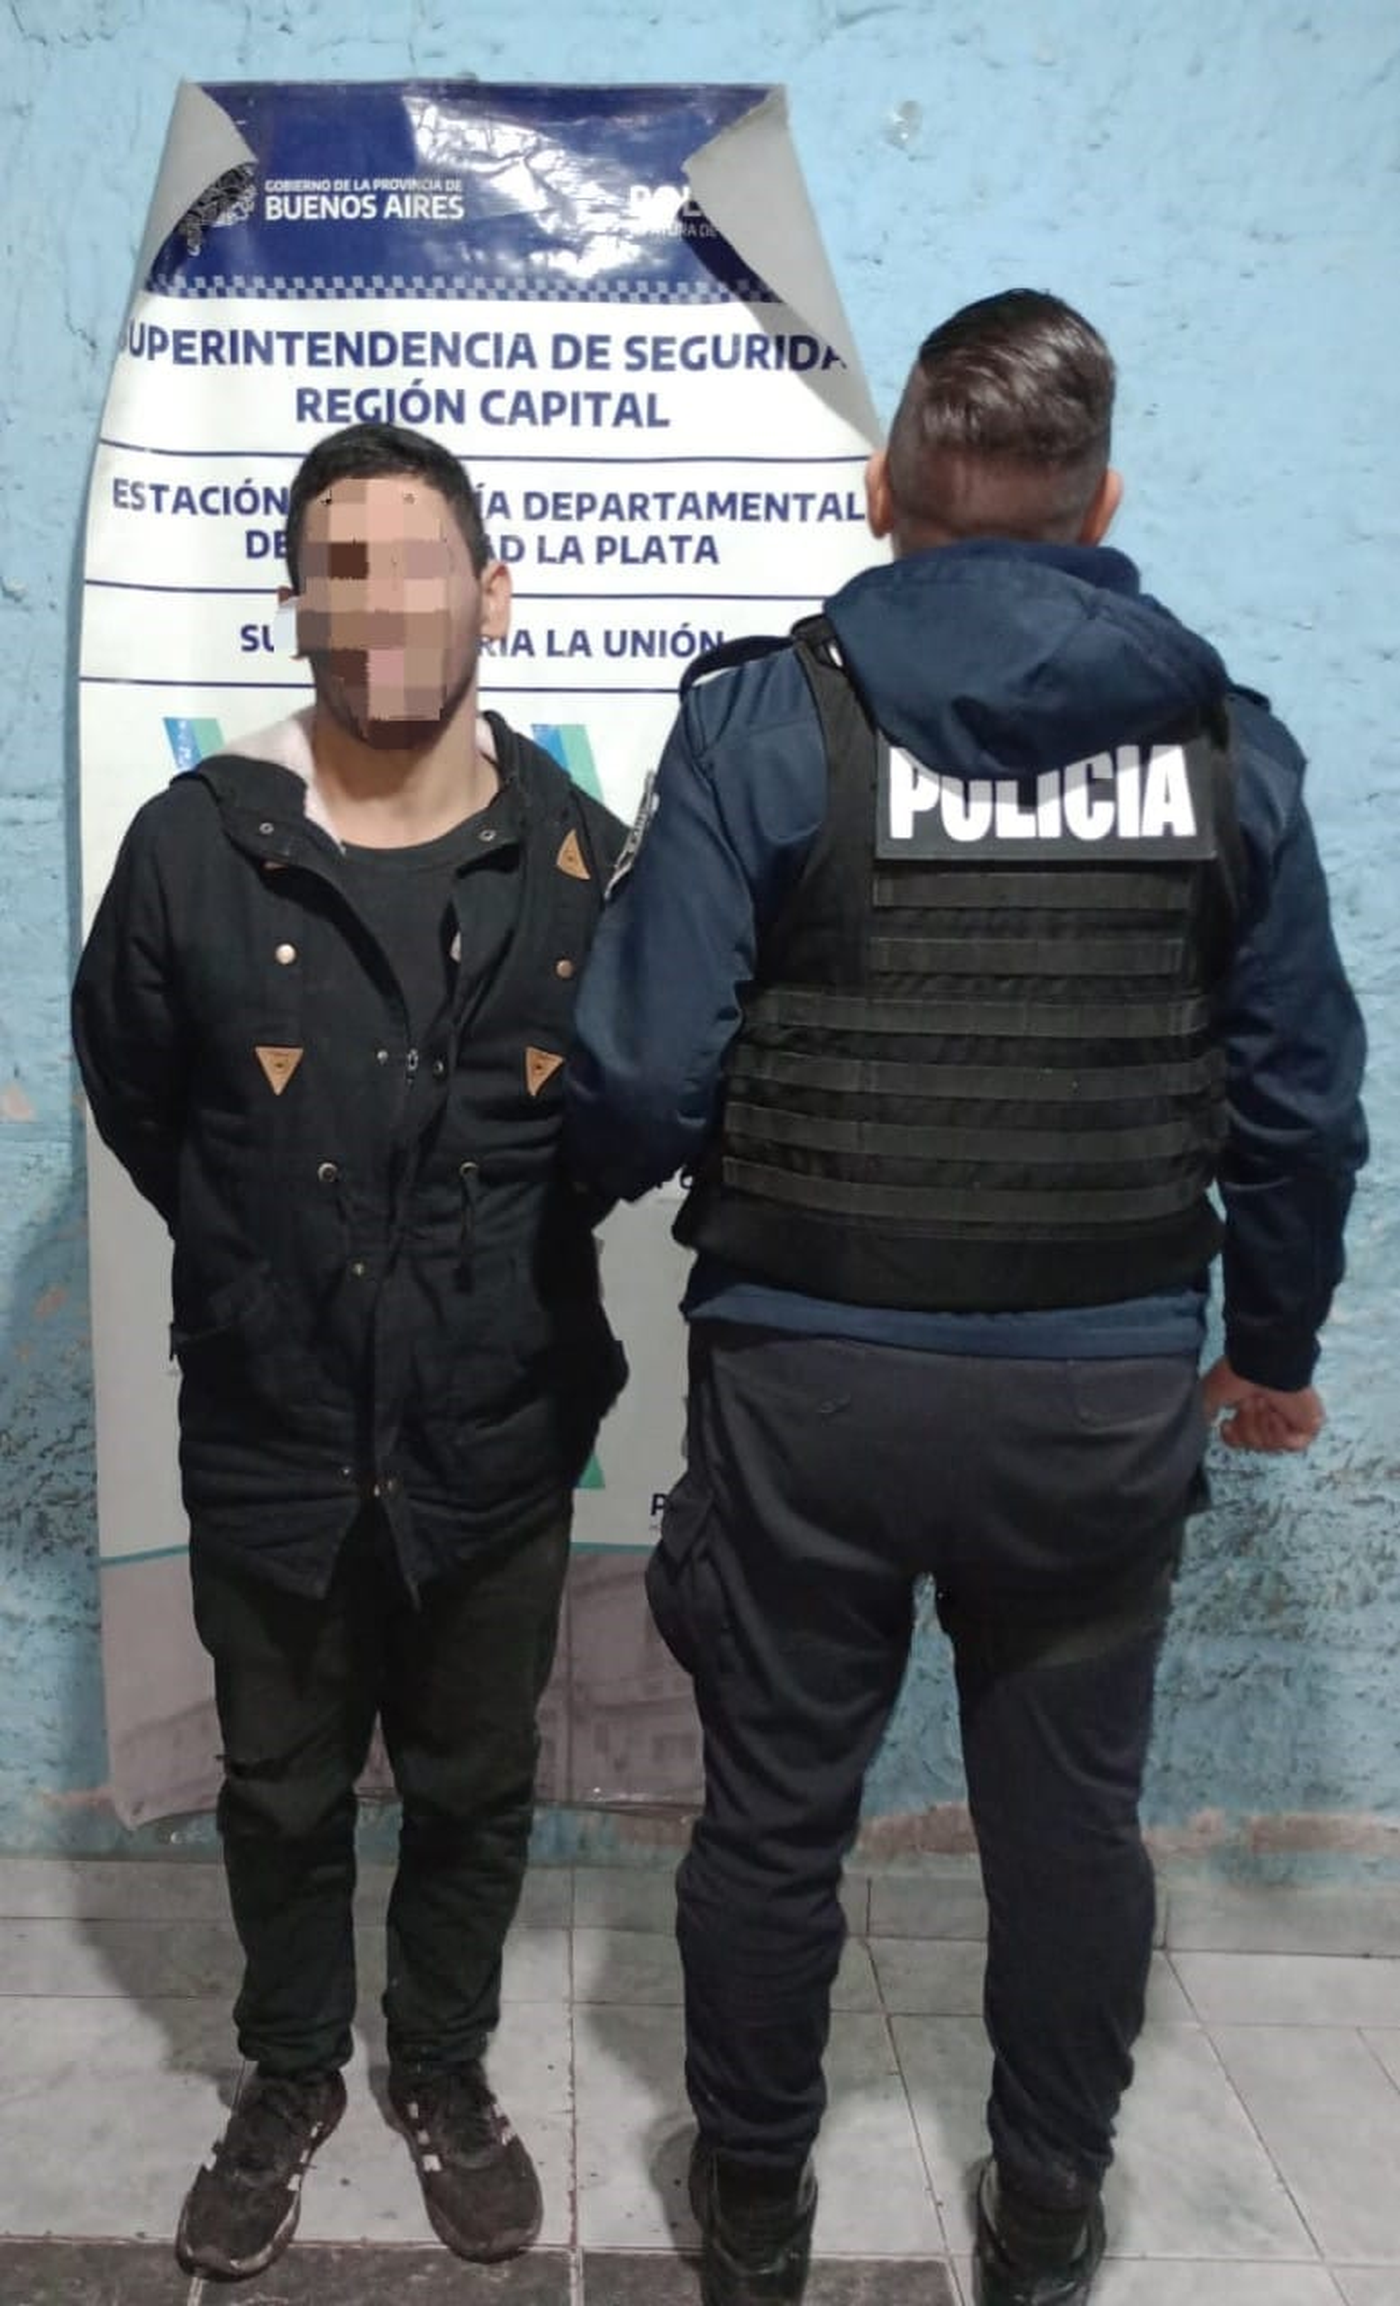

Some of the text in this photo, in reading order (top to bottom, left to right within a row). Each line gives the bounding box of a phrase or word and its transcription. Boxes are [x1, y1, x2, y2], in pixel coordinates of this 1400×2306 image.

[333, 180, 349, 192] DE
[353, 179, 370, 191] LA
[372, 178, 442, 191] PROVINCIA
[445, 179, 463, 192] DE
[264, 193, 465, 220] BUENOS AIRES
[118, 321, 848, 371] UPERINTENDENCIA DE SEGURIDA
[296, 378, 670, 428] REGIÓN CAPITAL
[112, 478, 288, 516] ESTACIÓN
[524, 491, 866, 522] DEPARTAMENTAL
[538, 535, 584, 564] LA
[596, 535, 720, 564] PLATA
[547, 629, 593, 658] LA
[604, 622, 723, 658] UNIÓN
[890, 745, 1196, 841] POLICIA
